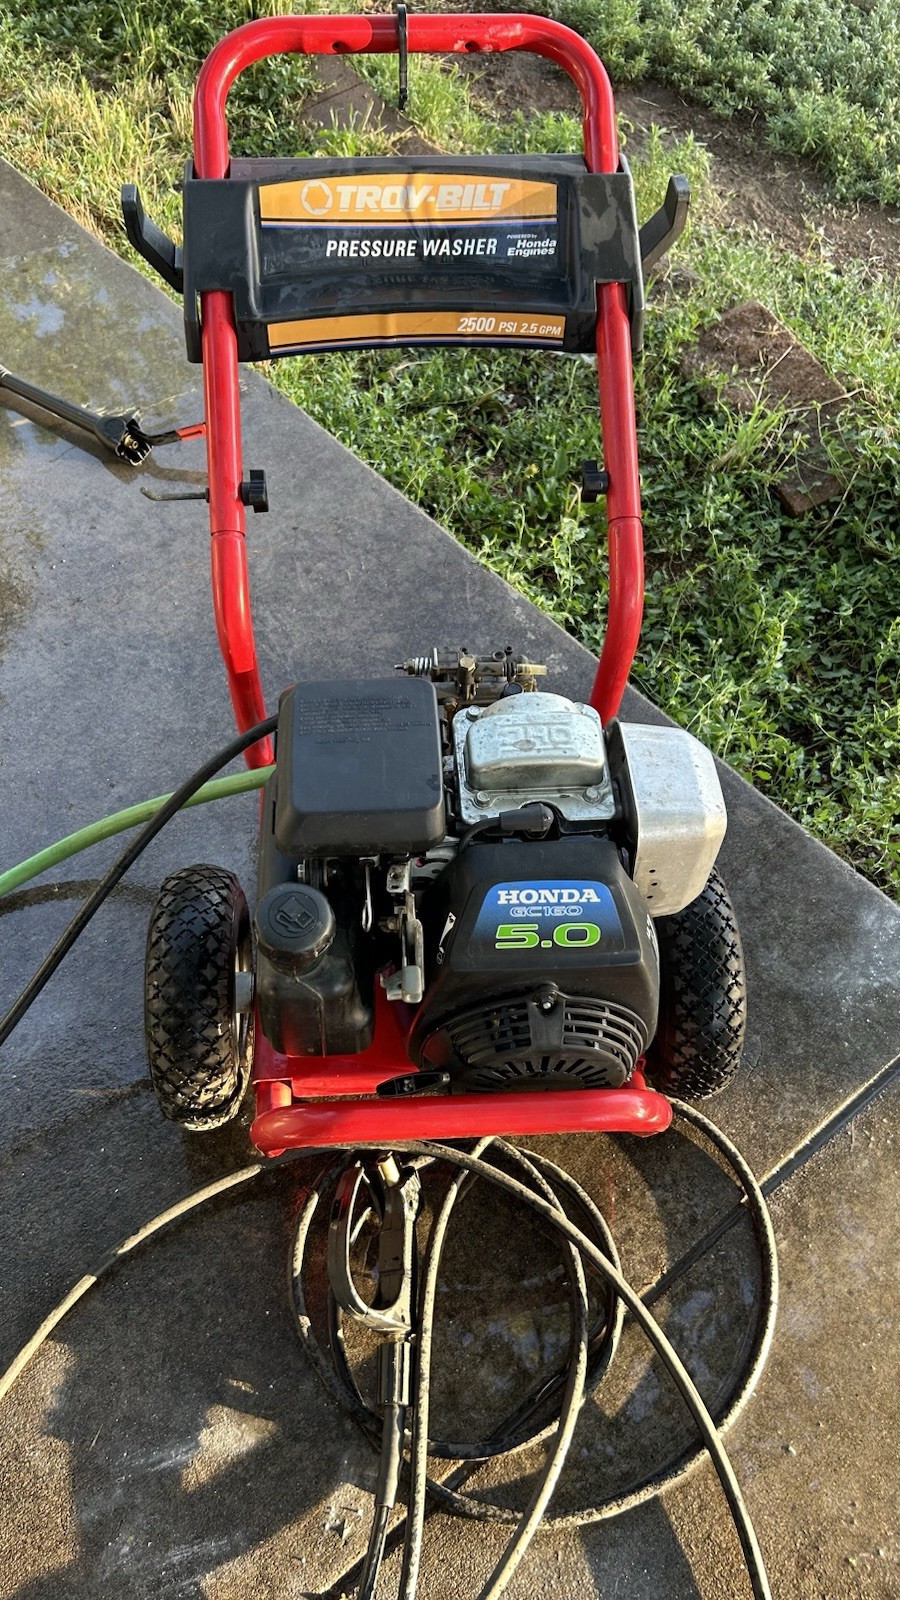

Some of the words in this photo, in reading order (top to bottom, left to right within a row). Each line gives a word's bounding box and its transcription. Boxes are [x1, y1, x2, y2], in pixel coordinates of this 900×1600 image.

[336, 184, 510, 212] TROY-BILT
[325, 239, 417, 257] PRESSURE
[422, 238, 498, 255] WASHER
[507, 247, 555, 257] Engines
[516, 239, 557, 248] Honda
[457, 317, 496, 333] 2500
[498, 322, 517, 333] PSI
[520, 323, 538, 334] 2.5
[539, 325, 562, 336] GPM
[497, 889, 601, 905] HONDA
[509, 905, 583, 918] GC160
[495, 922, 601, 949] 5.0
